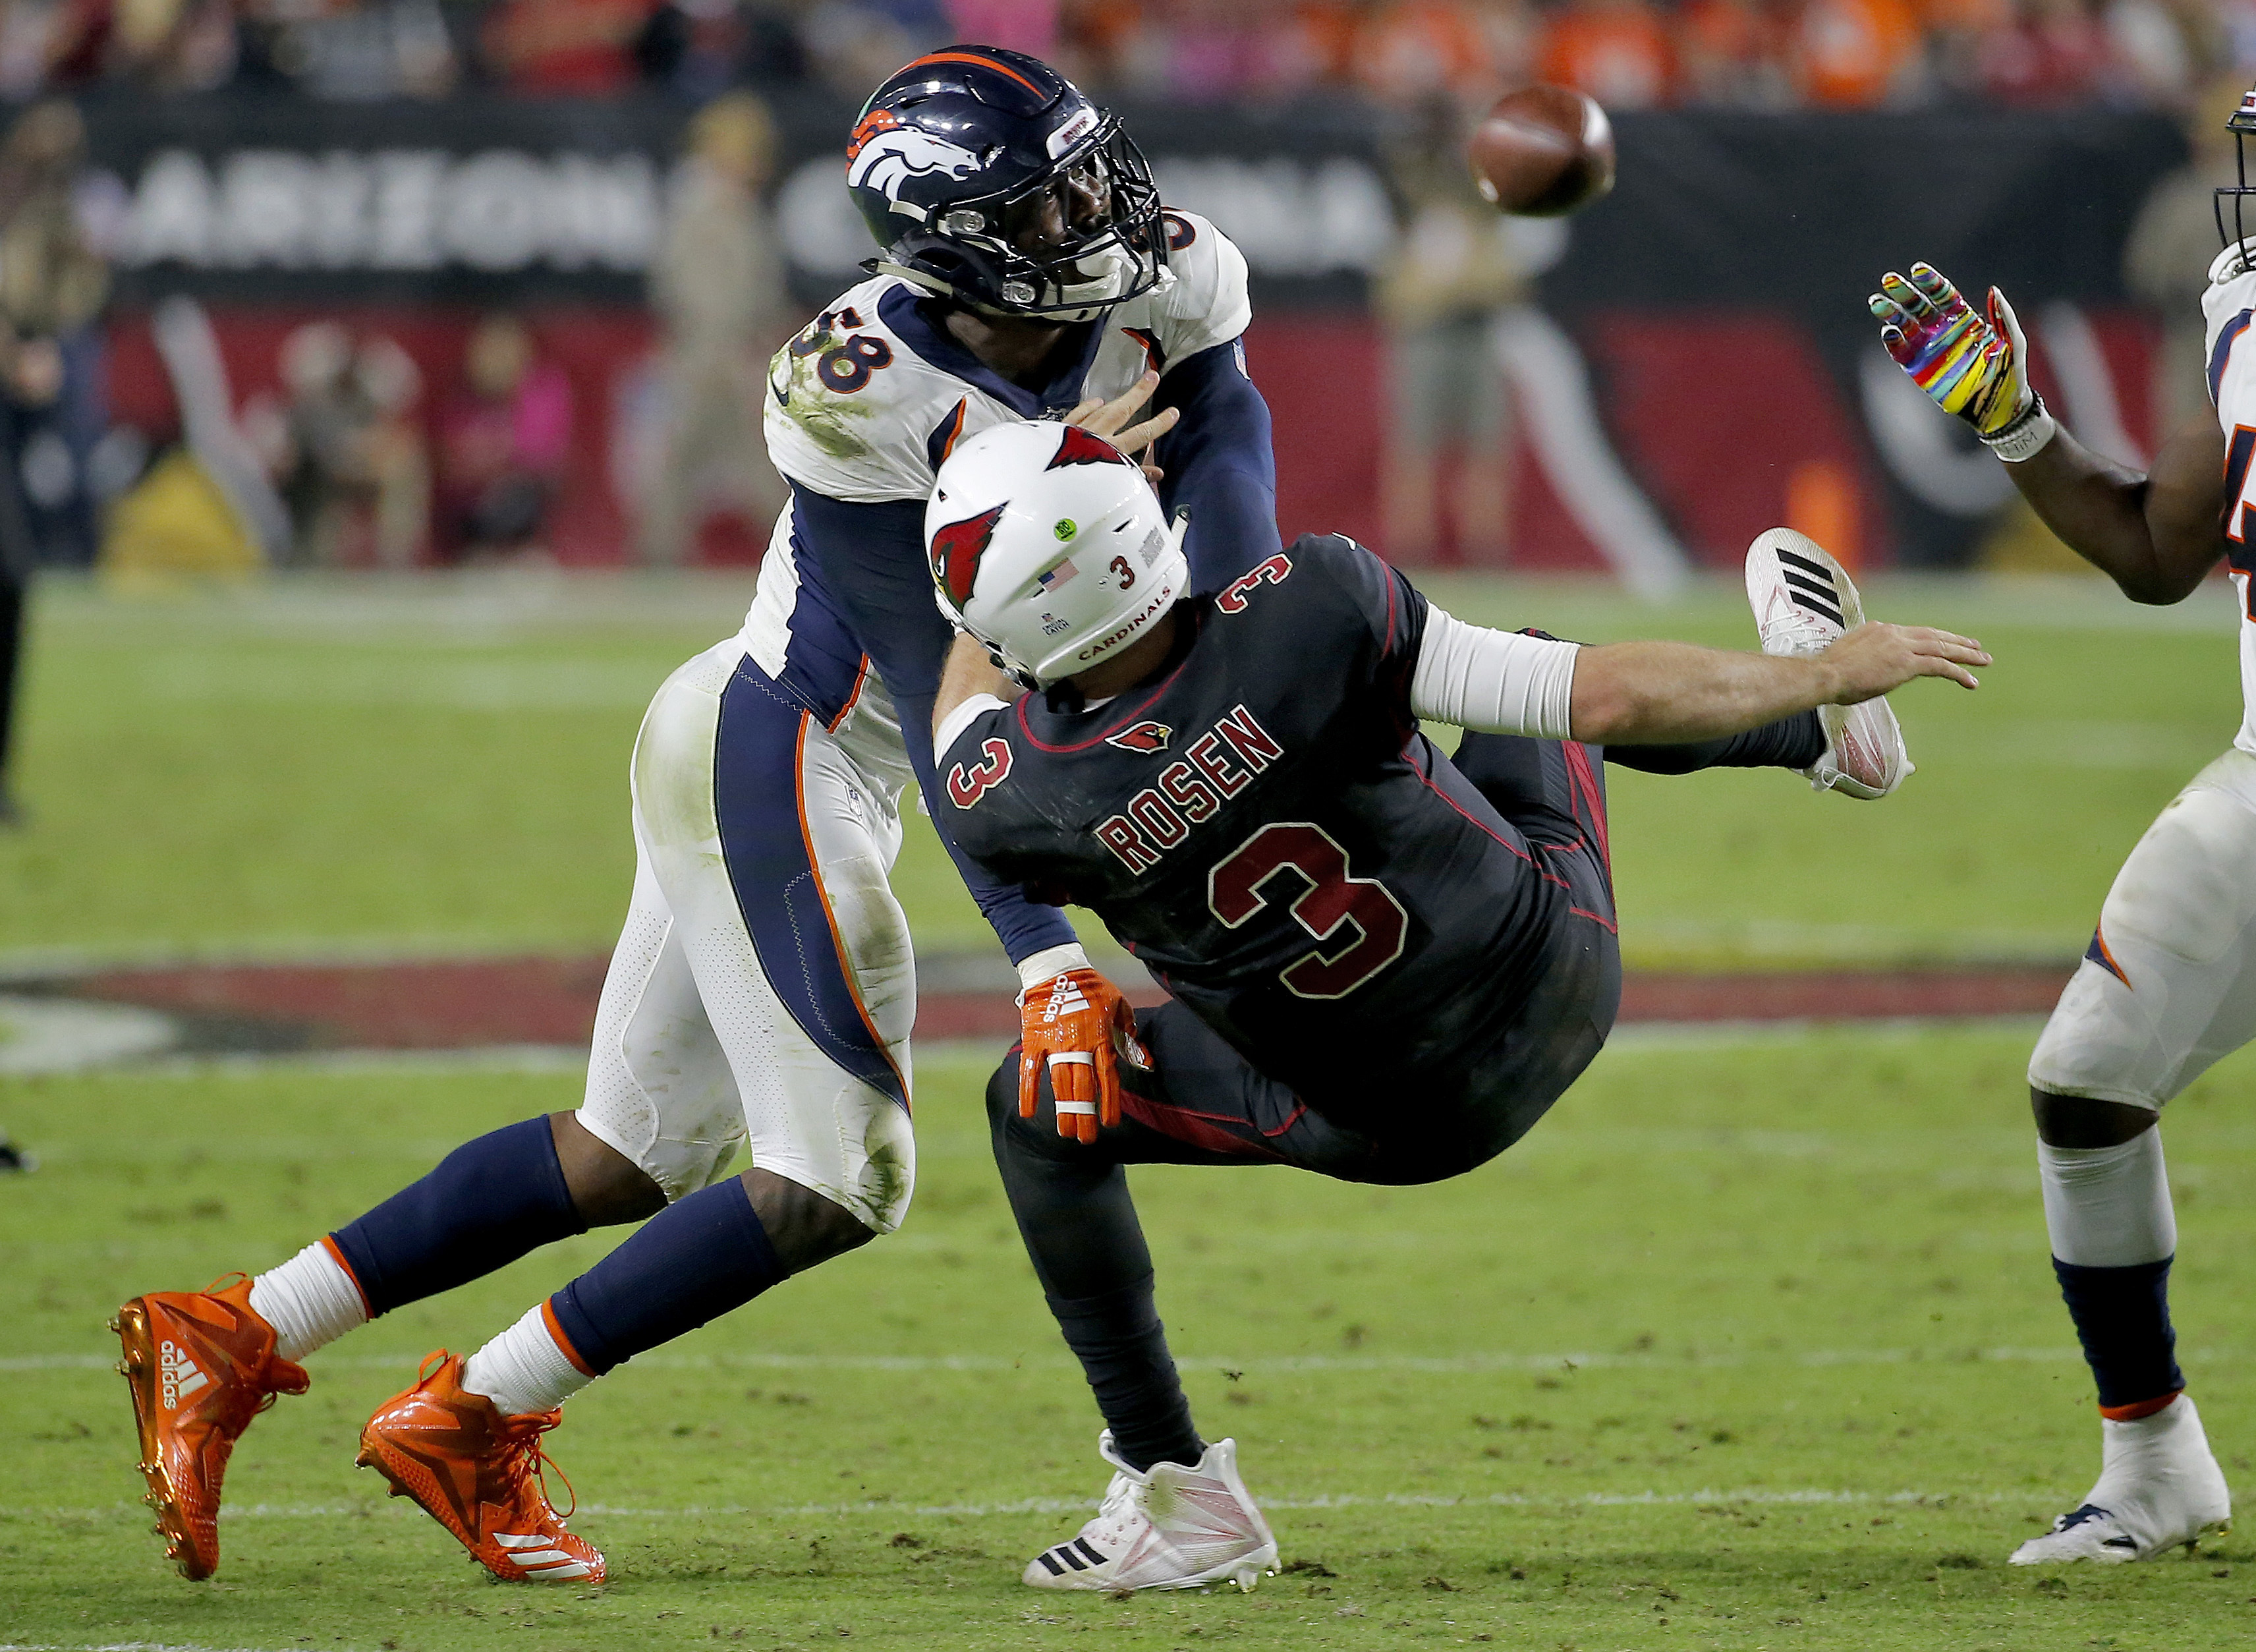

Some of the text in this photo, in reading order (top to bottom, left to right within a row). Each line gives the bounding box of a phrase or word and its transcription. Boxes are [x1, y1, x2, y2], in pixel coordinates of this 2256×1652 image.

[789, 306, 893, 394] 58
[1110, 555, 1135, 590] 3
[1214, 552, 1294, 614] 3
[1079, 585, 1172, 661] CARDINALS
[945, 736, 1014, 811] 3
[1092, 702, 1285, 877] ROSEN
[1207, 821, 1409, 1000] 3
[1042, 974, 1069, 1024] adidas
[159, 1338, 178, 1411] adidas
